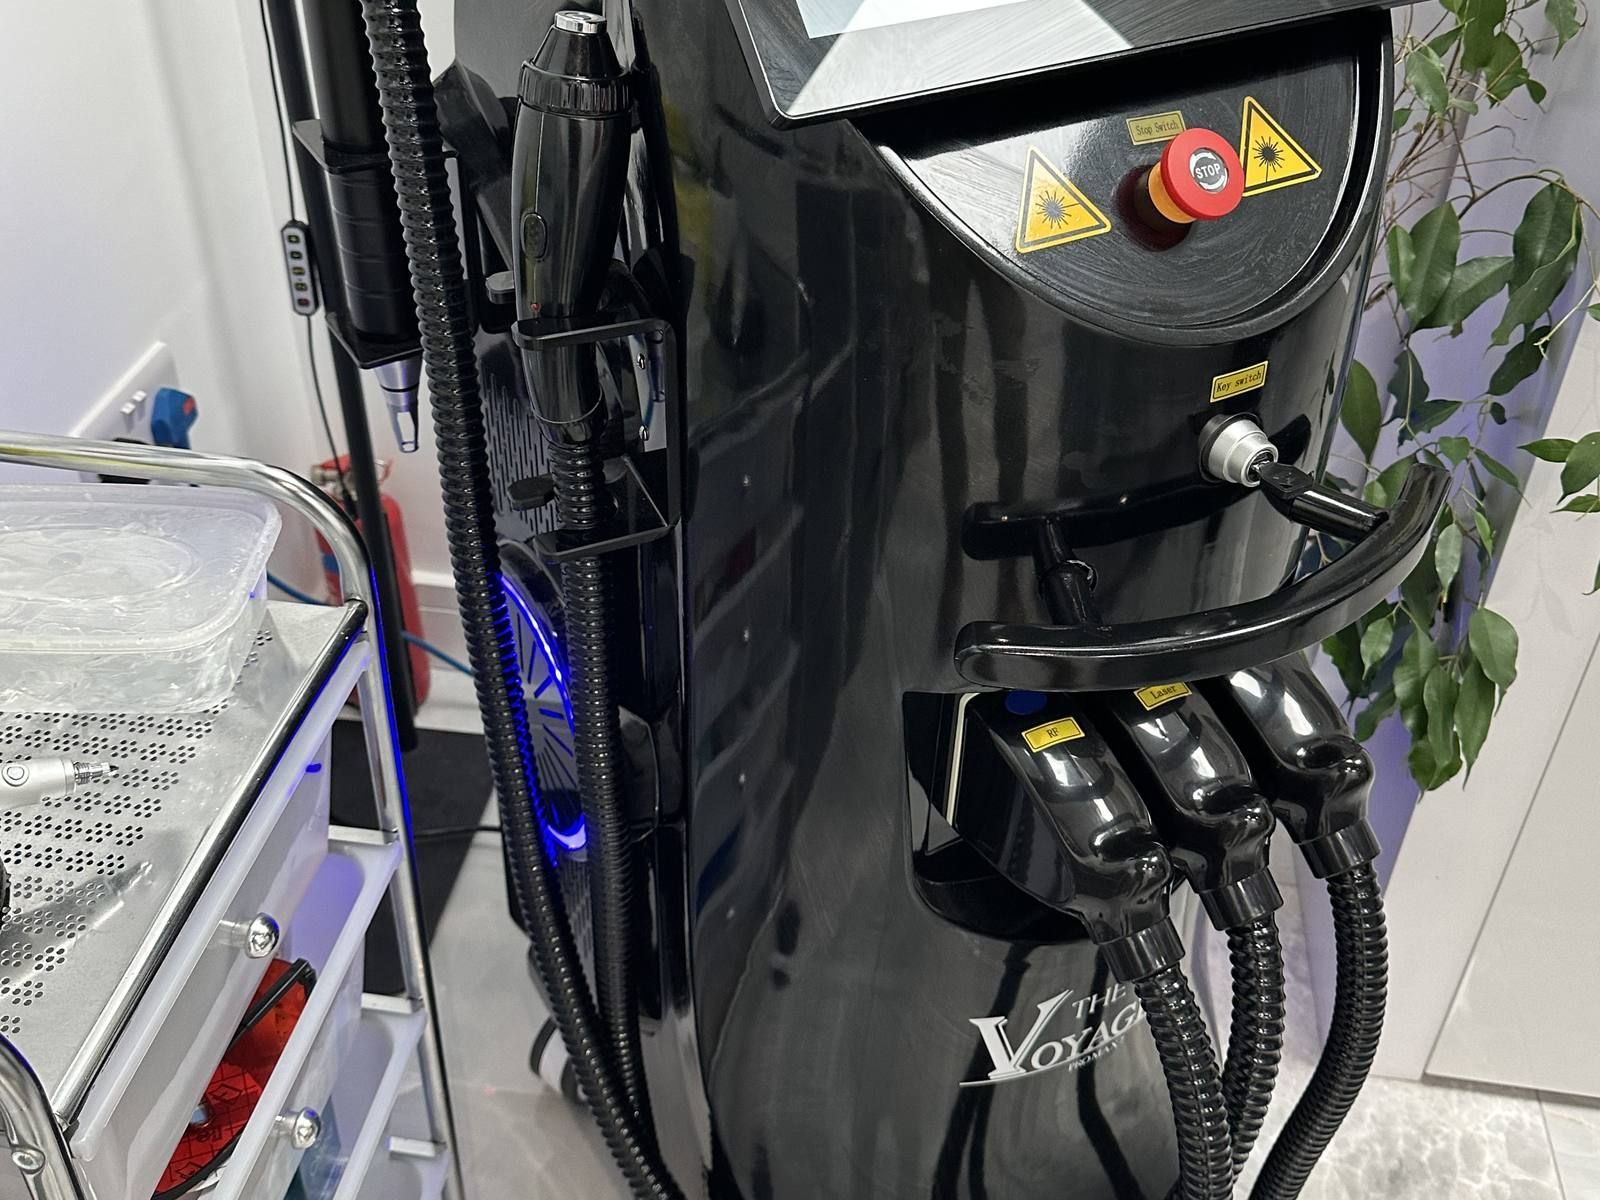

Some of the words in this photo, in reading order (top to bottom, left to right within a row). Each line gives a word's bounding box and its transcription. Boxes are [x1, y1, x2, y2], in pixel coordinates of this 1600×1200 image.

[1135, 125, 1153, 136] Stop
[1155, 119, 1179, 133] Switch
[1195, 163, 1221, 179] STOP
[1216, 381, 1232, 393] Key
[1235, 370, 1262, 387] switch
[1150, 685, 1177, 700] Laser
[1047, 727, 1060, 739] RF
[1072, 983, 1127, 1019] THE
